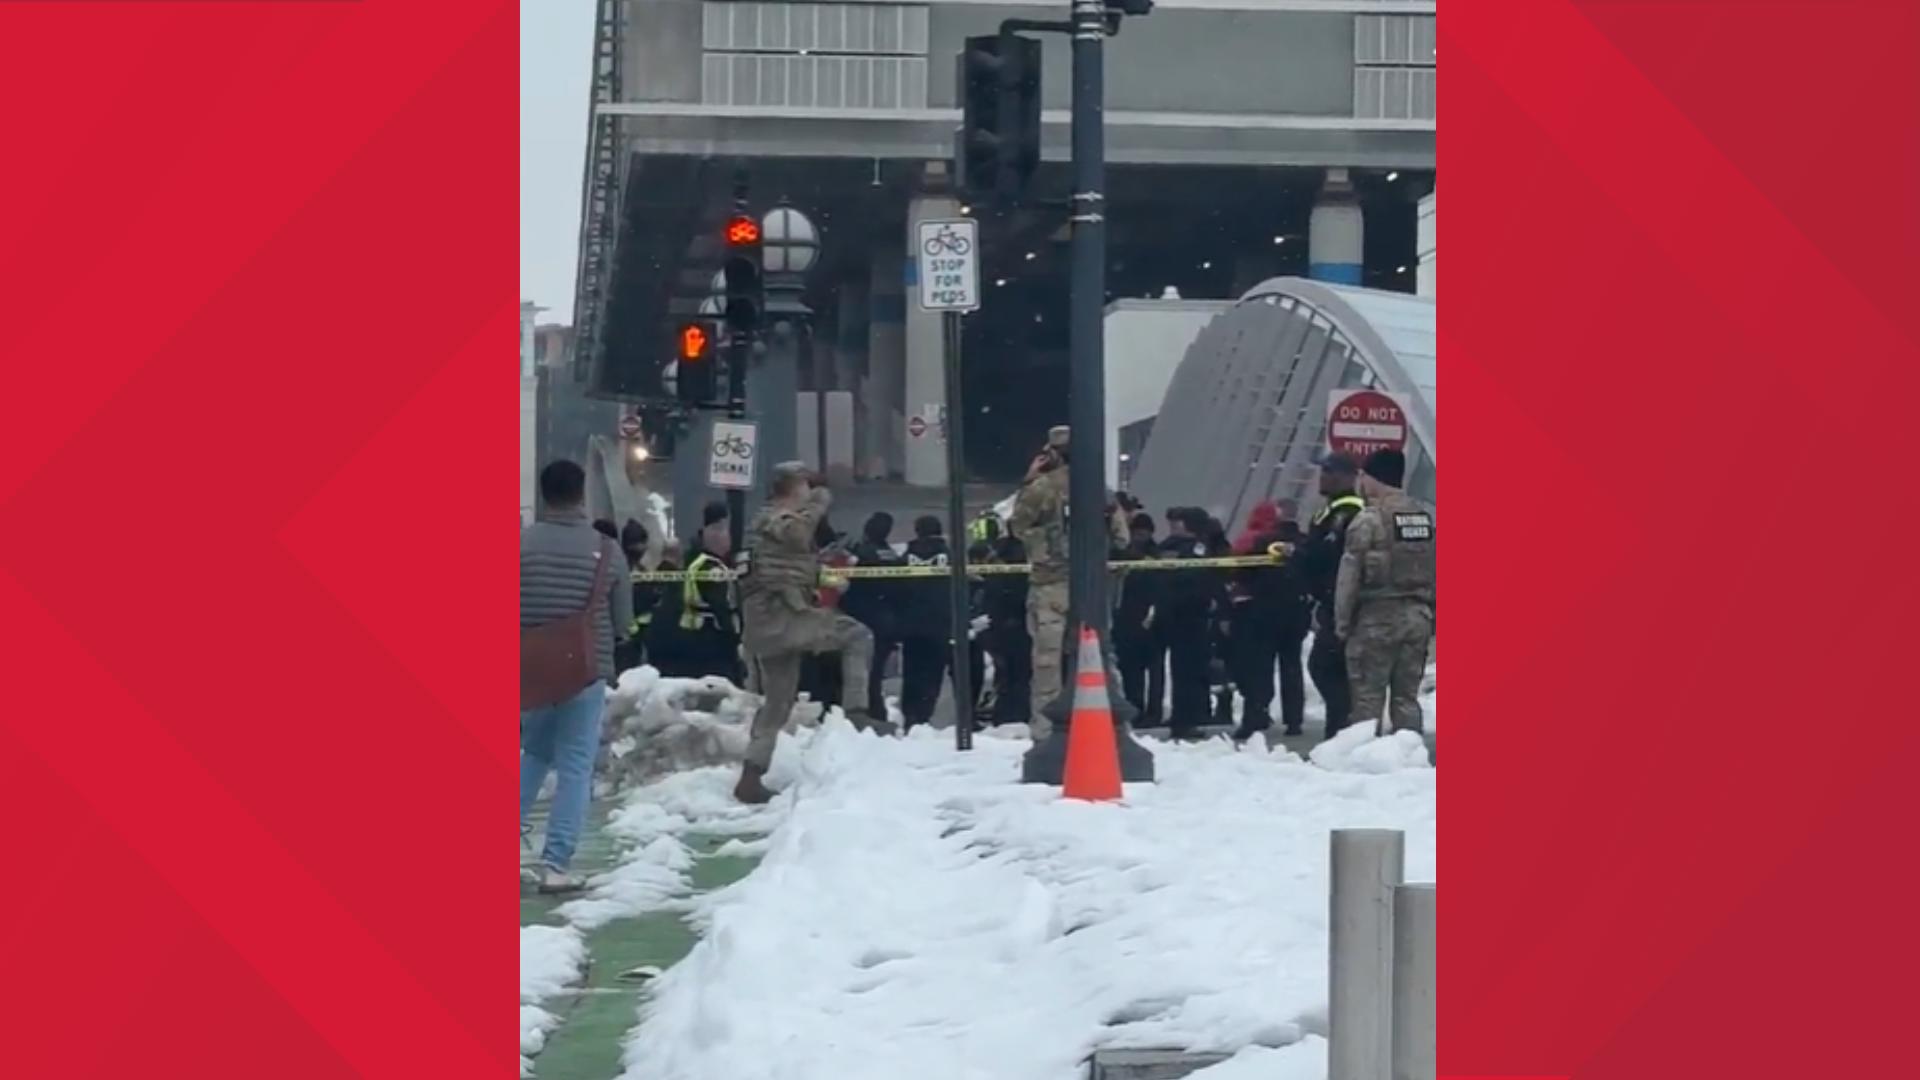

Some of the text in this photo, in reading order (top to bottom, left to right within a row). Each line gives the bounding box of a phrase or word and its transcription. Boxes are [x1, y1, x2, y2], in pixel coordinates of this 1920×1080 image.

[930, 259, 965, 271] STOP
[935, 275, 962, 288] FOR
[931, 290, 967, 303] PEDS
[1340, 406, 1398, 421] DO NOT
[713, 461, 749, 476] SIGNAL
